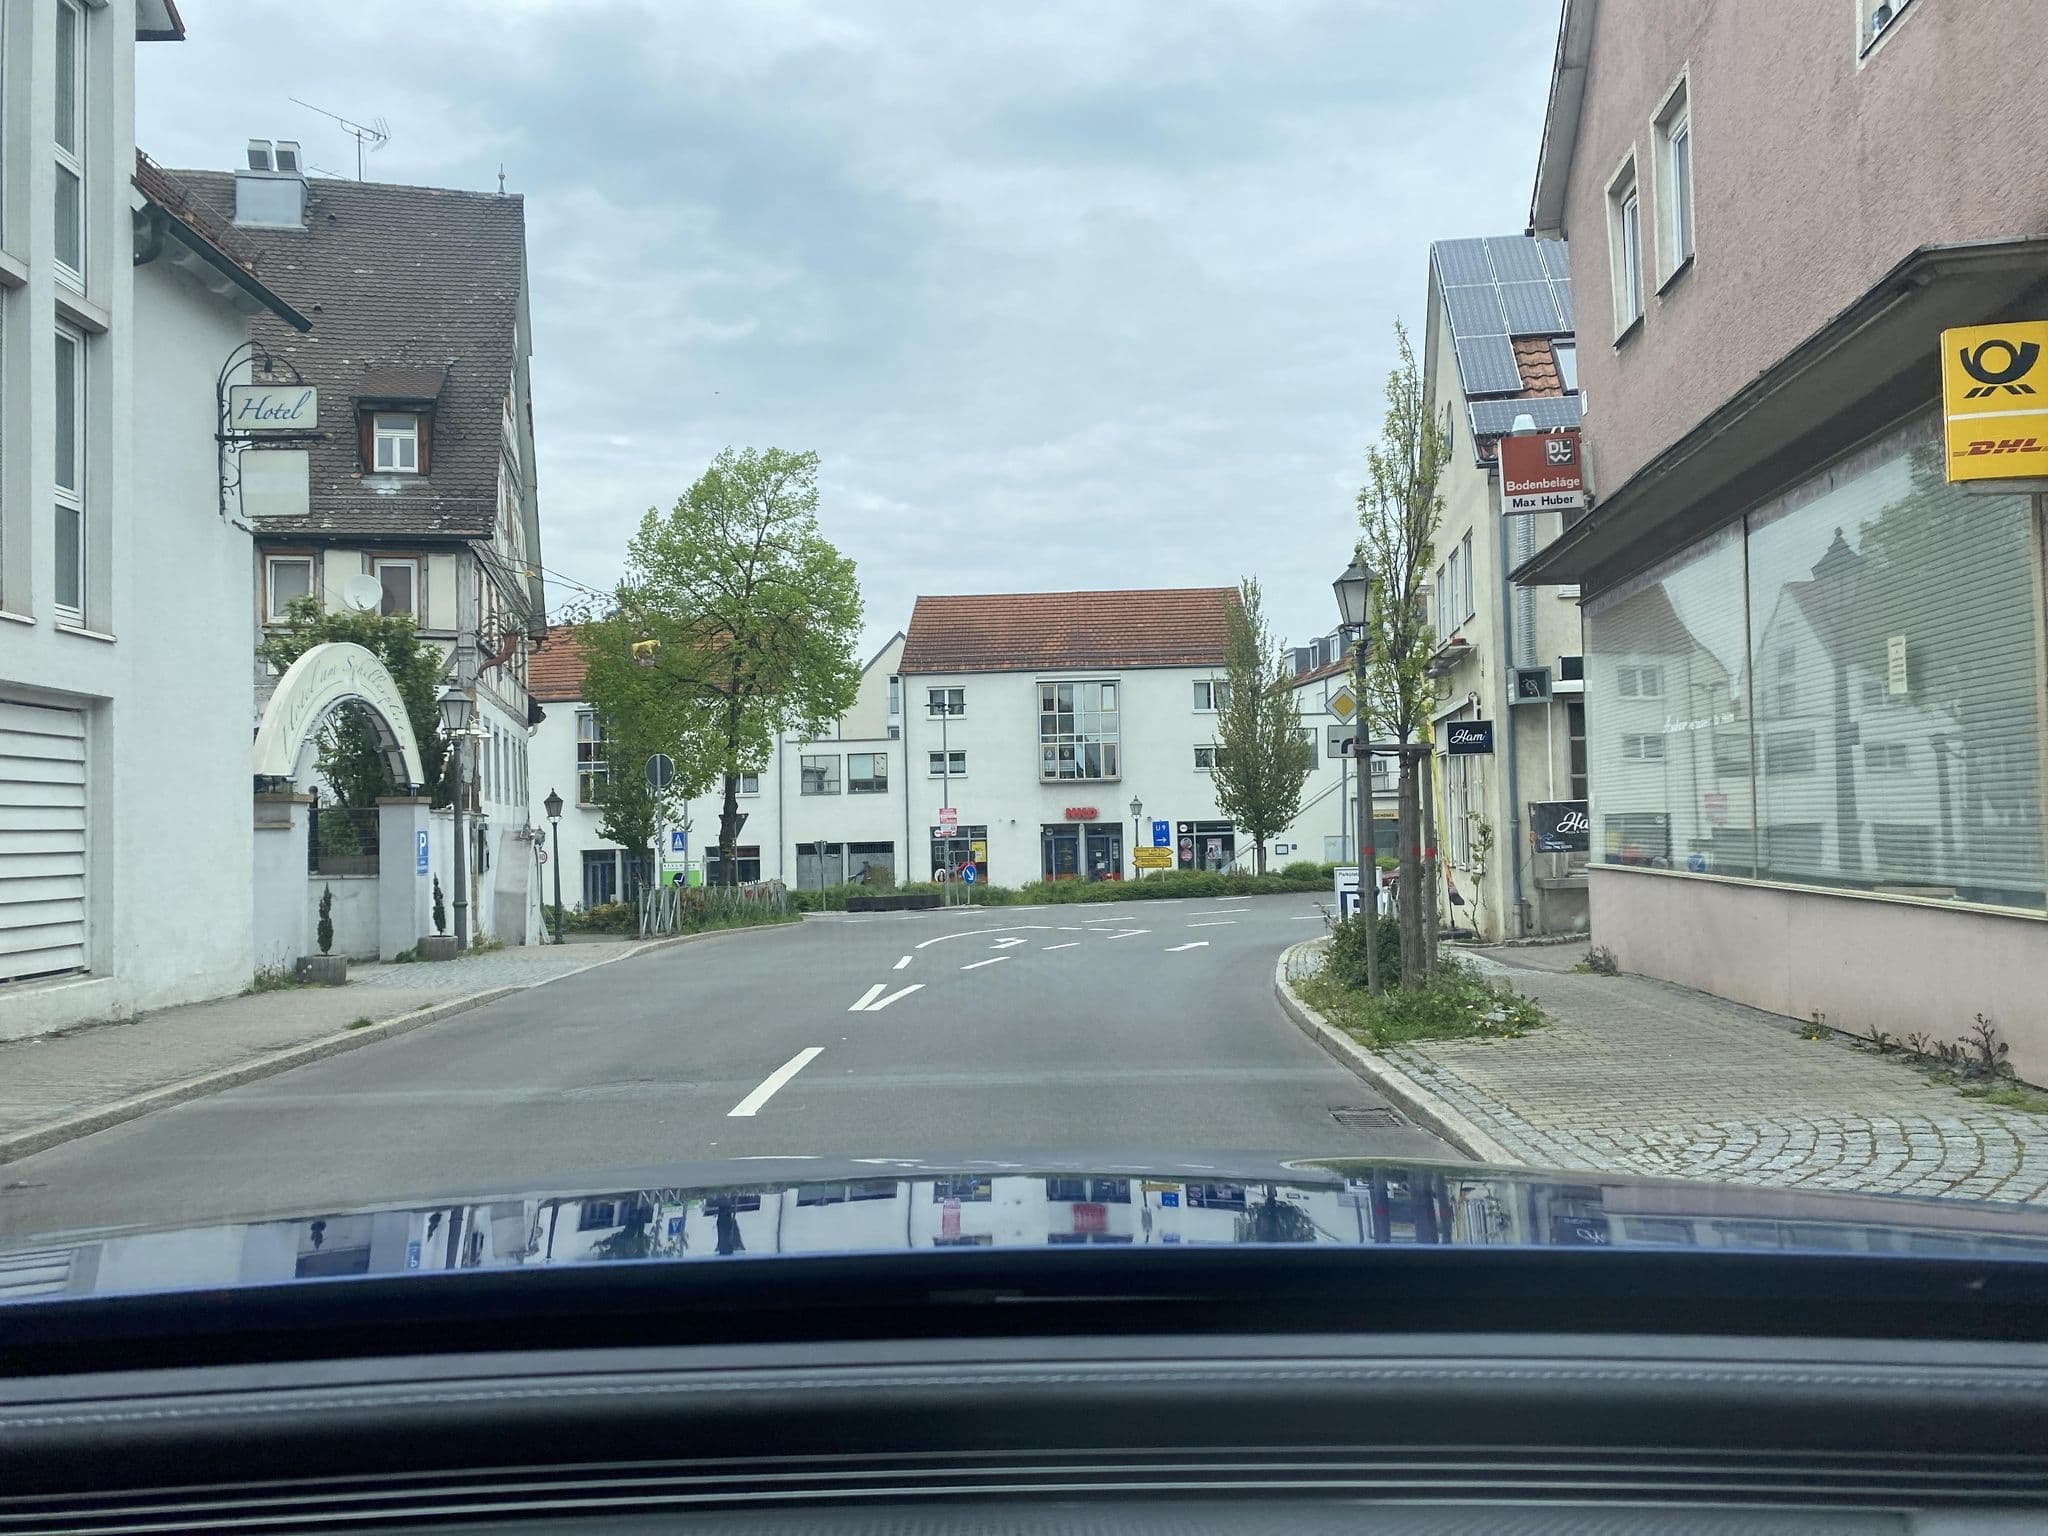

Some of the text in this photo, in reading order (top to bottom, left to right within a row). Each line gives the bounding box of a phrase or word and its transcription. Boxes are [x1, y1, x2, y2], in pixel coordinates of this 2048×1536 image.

[237, 390, 312, 420] Hotel
[1967, 438, 2042, 457] DHL
[1506, 477, 1580, 492] Bodenbeläge
[1512, 495, 1574, 509] Max Huber
[1556, 811, 1589, 833] Ha
[419, 833, 427, 856] P
